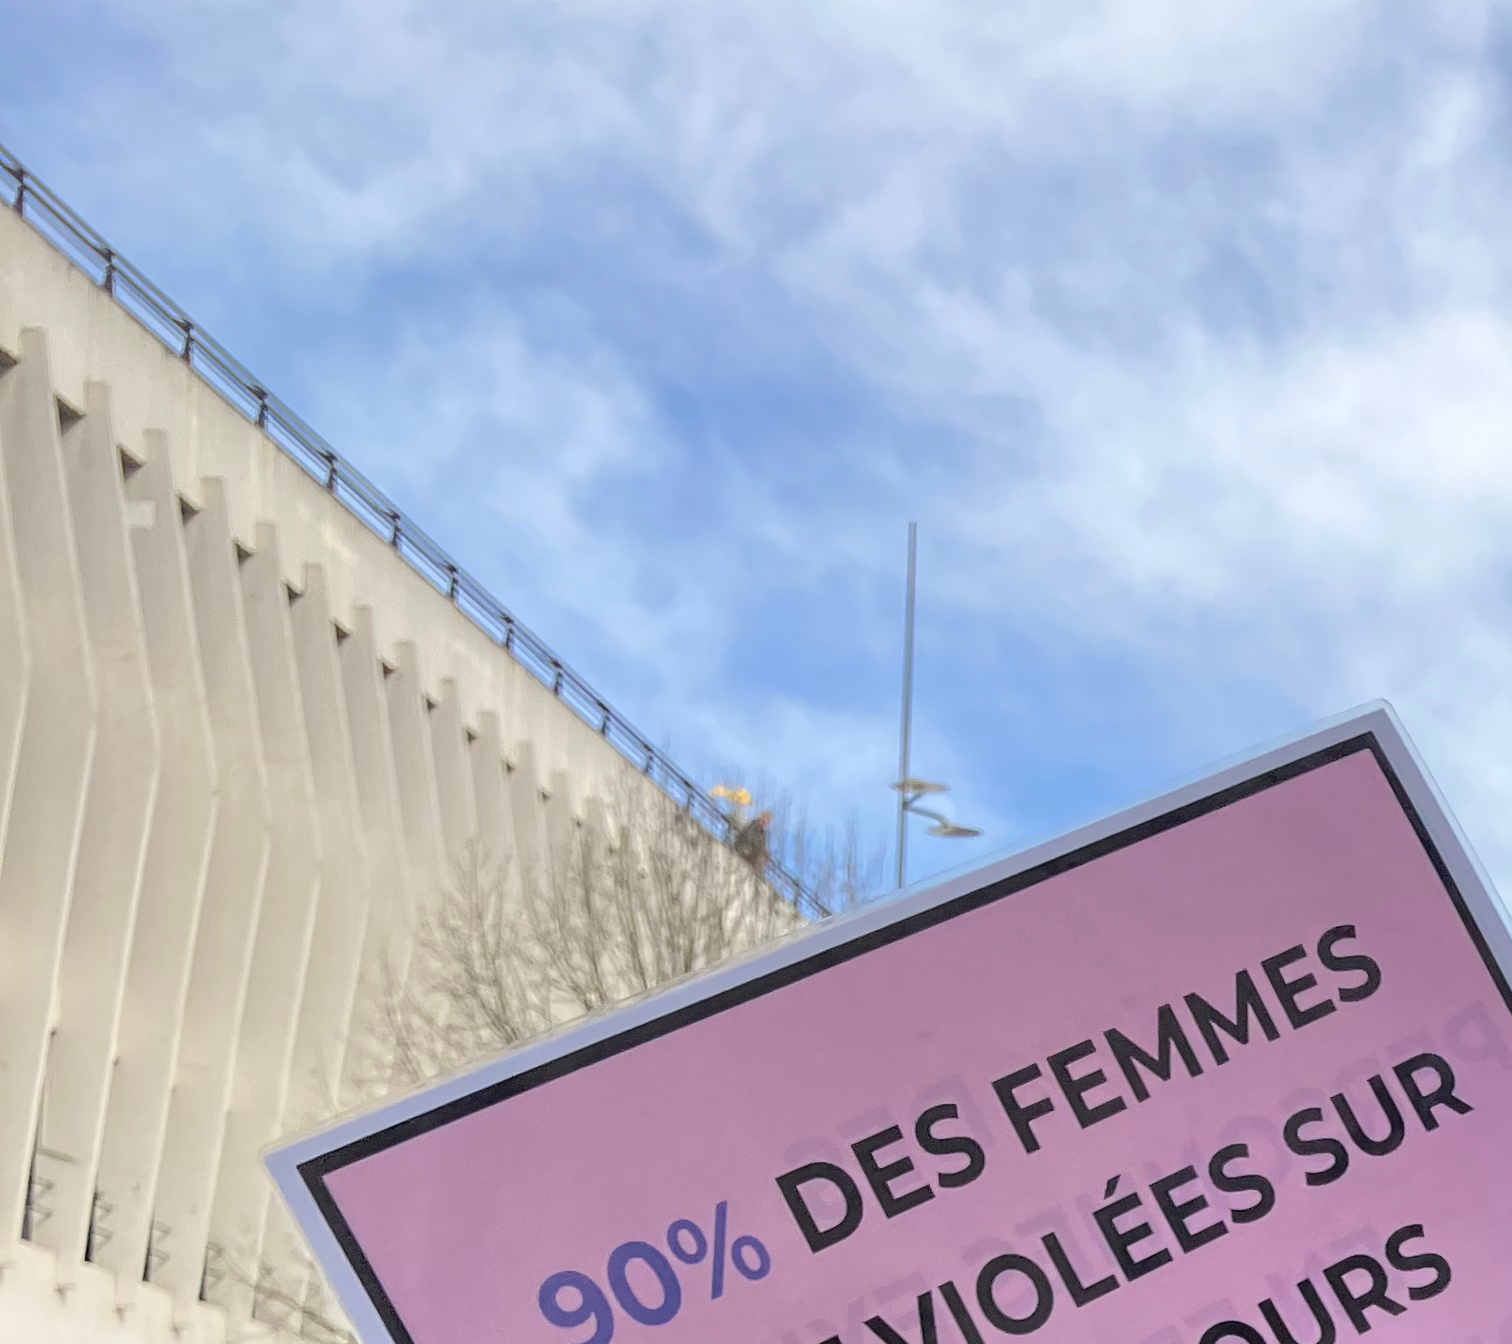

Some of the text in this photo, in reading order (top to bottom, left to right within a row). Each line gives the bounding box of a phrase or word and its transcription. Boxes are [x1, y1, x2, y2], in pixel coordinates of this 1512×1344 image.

[774, 1103, 986, 1254] DES
[990, 924, 1382, 1155] FEMMES
[1282, 1052, 1475, 1187] SUR
